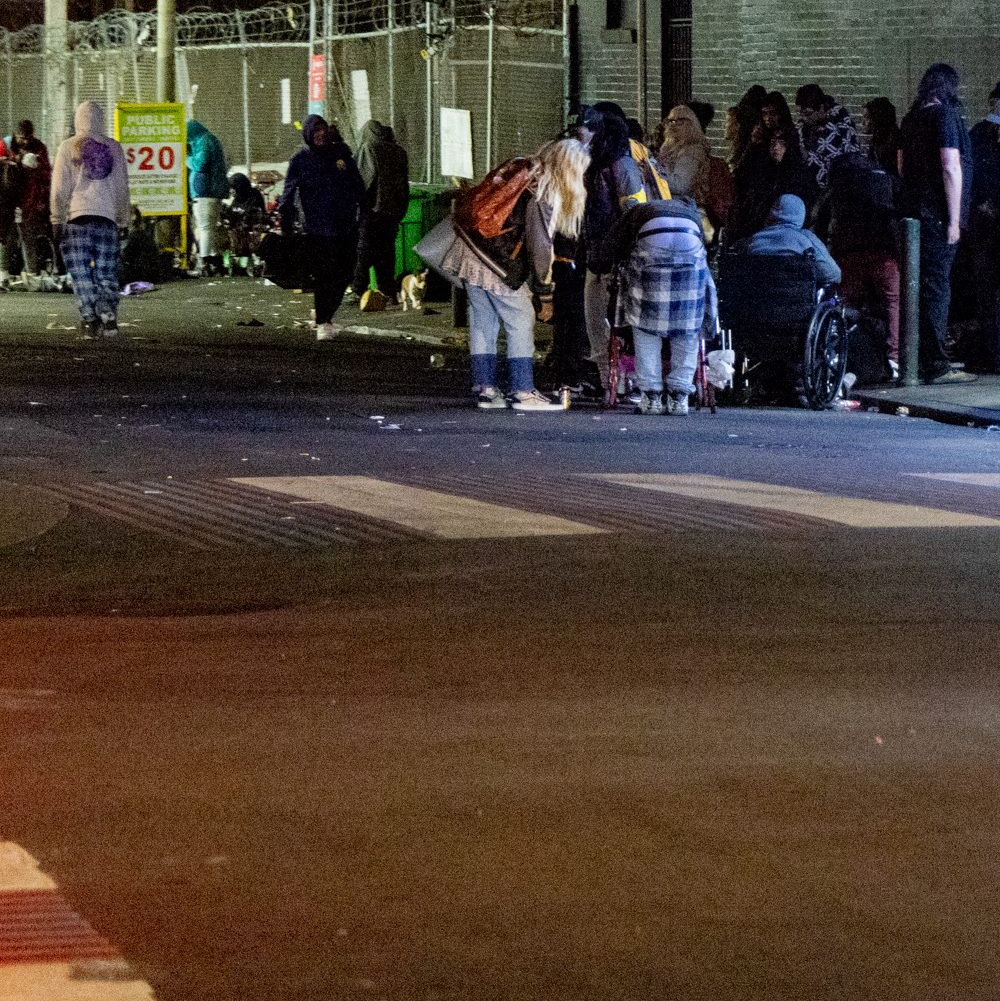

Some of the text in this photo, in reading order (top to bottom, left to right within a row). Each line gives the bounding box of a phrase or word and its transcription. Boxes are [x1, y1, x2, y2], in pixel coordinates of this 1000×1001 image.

[127, 115, 175, 125] PUBLIC
[122, 126, 180, 136] PARKING
[127, 146, 175, 170] $20
